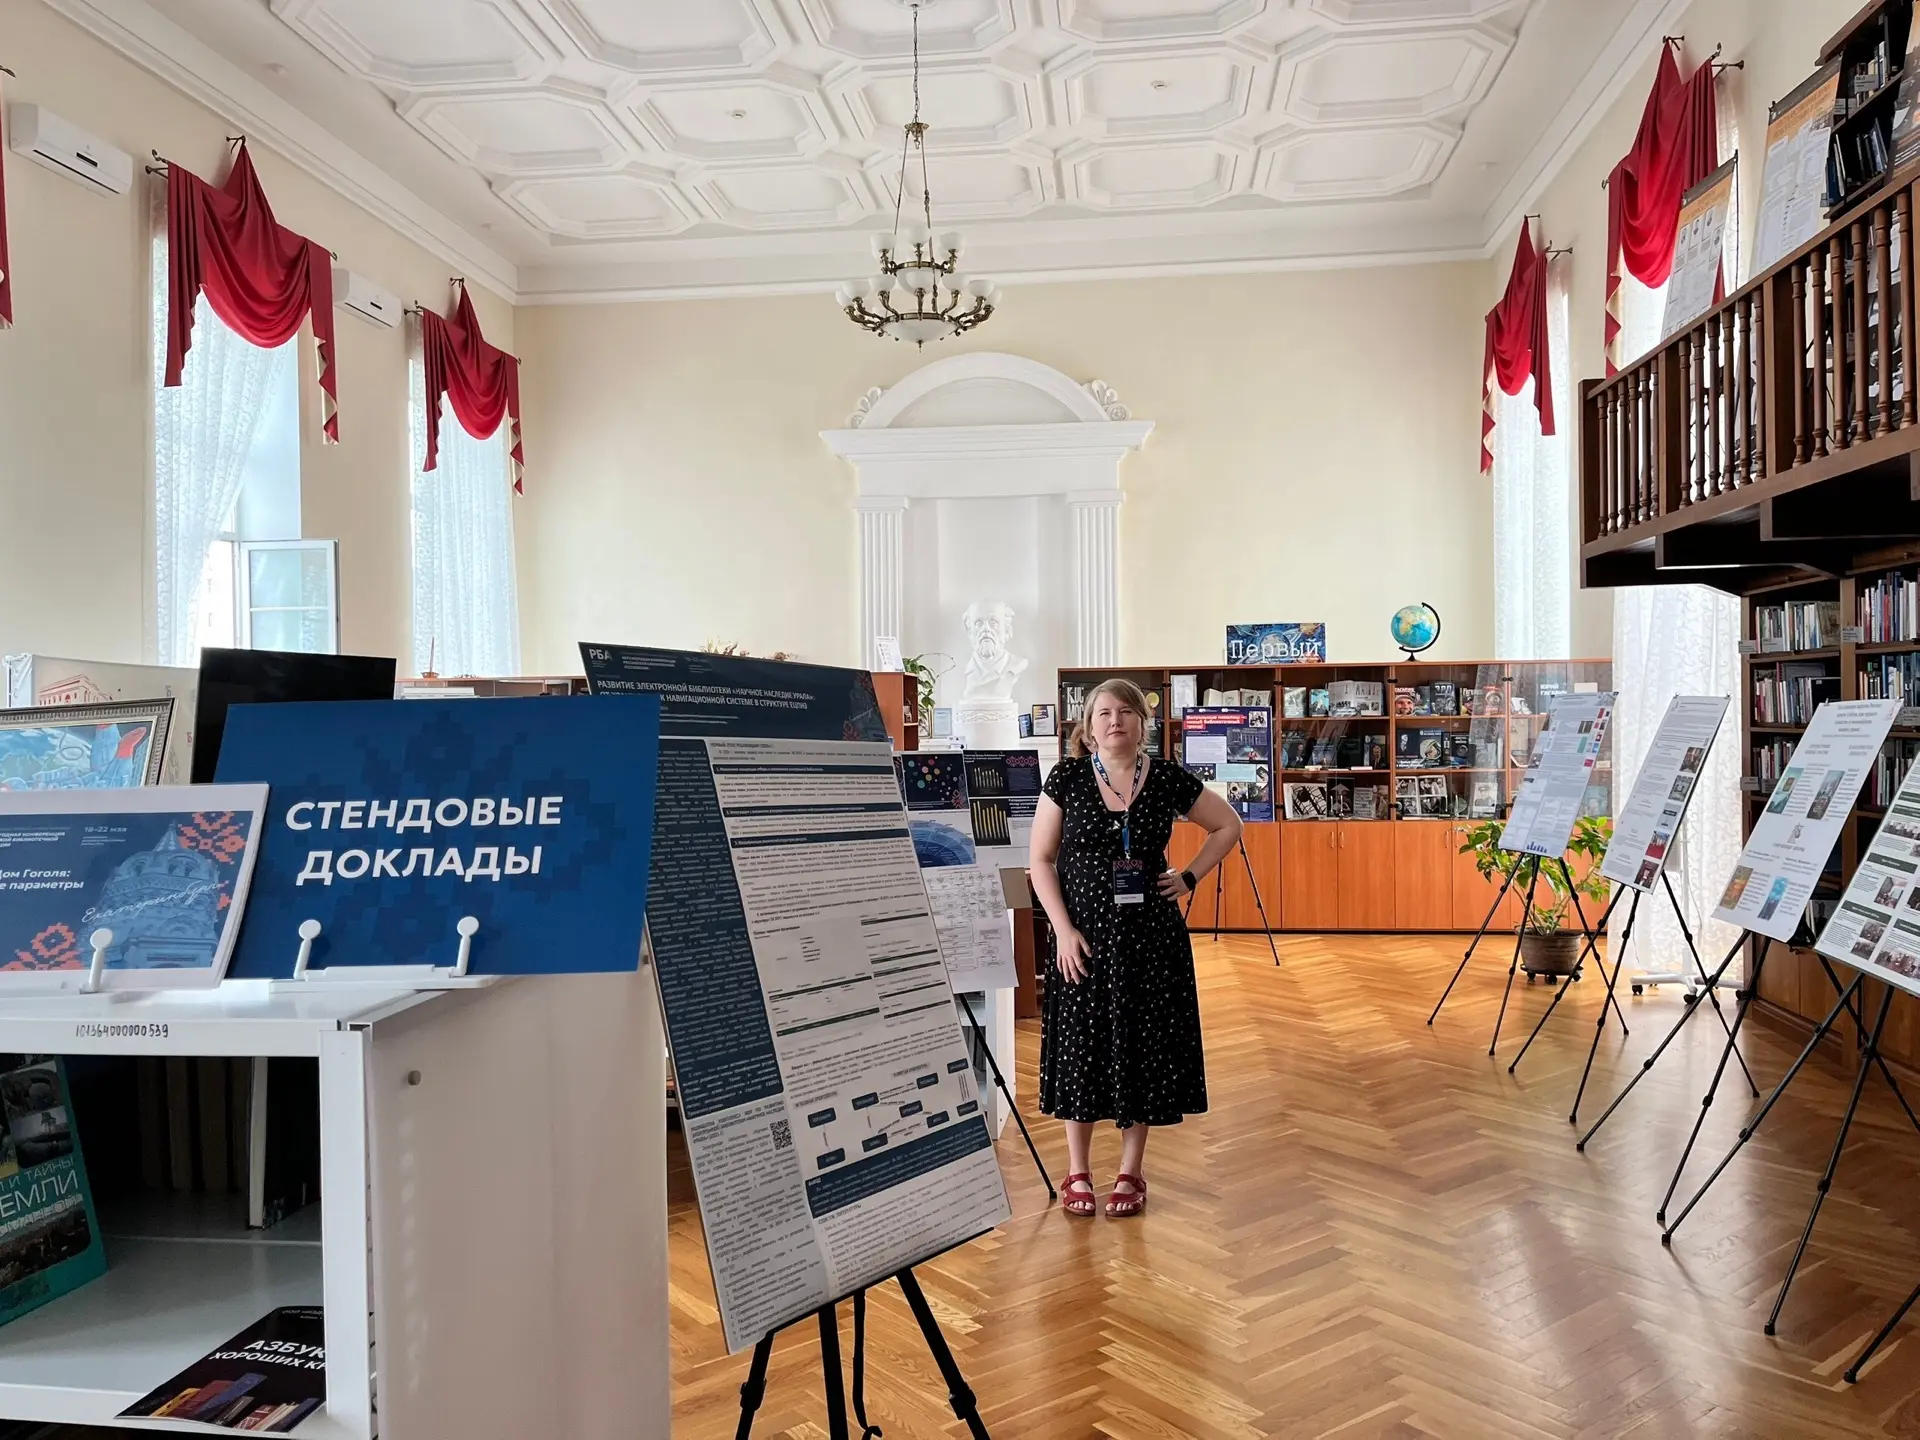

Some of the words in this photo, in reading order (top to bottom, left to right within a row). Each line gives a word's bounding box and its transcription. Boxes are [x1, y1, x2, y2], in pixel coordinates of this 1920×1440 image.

[588, 648, 613, 661] РБА
[1231, 638, 1322, 664] Первый
[597, 680, 635, 690] РАЗВИТИЕ
[636, 681, 688, 692] ЭЛЕКТРОННОЙ
[688, 684, 732, 695] БИБЛИОТЕКИ
[666, 694, 725, 706] НАВИГАЦИОННОЙ
[726, 697, 754, 707] СИСТЕМЕ
[760, 699, 789, 709] СТРУКТУРЕ
[285, 795, 563, 832] СТЕНДОВЫЕ
[23, 868, 71, 879] Гоголя:
[296, 845, 544, 886] ДОКЛАДЫ
[9, 881, 85, 892] параметры
[24, 1156, 75, 1182] ТАЙНЫ
[0, 1169, 79, 1219] ЕМЛИ
[243, 1339, 326, 1359] АЗБУК
[208, 1351, 303, 1368] ХОРОШИХ
